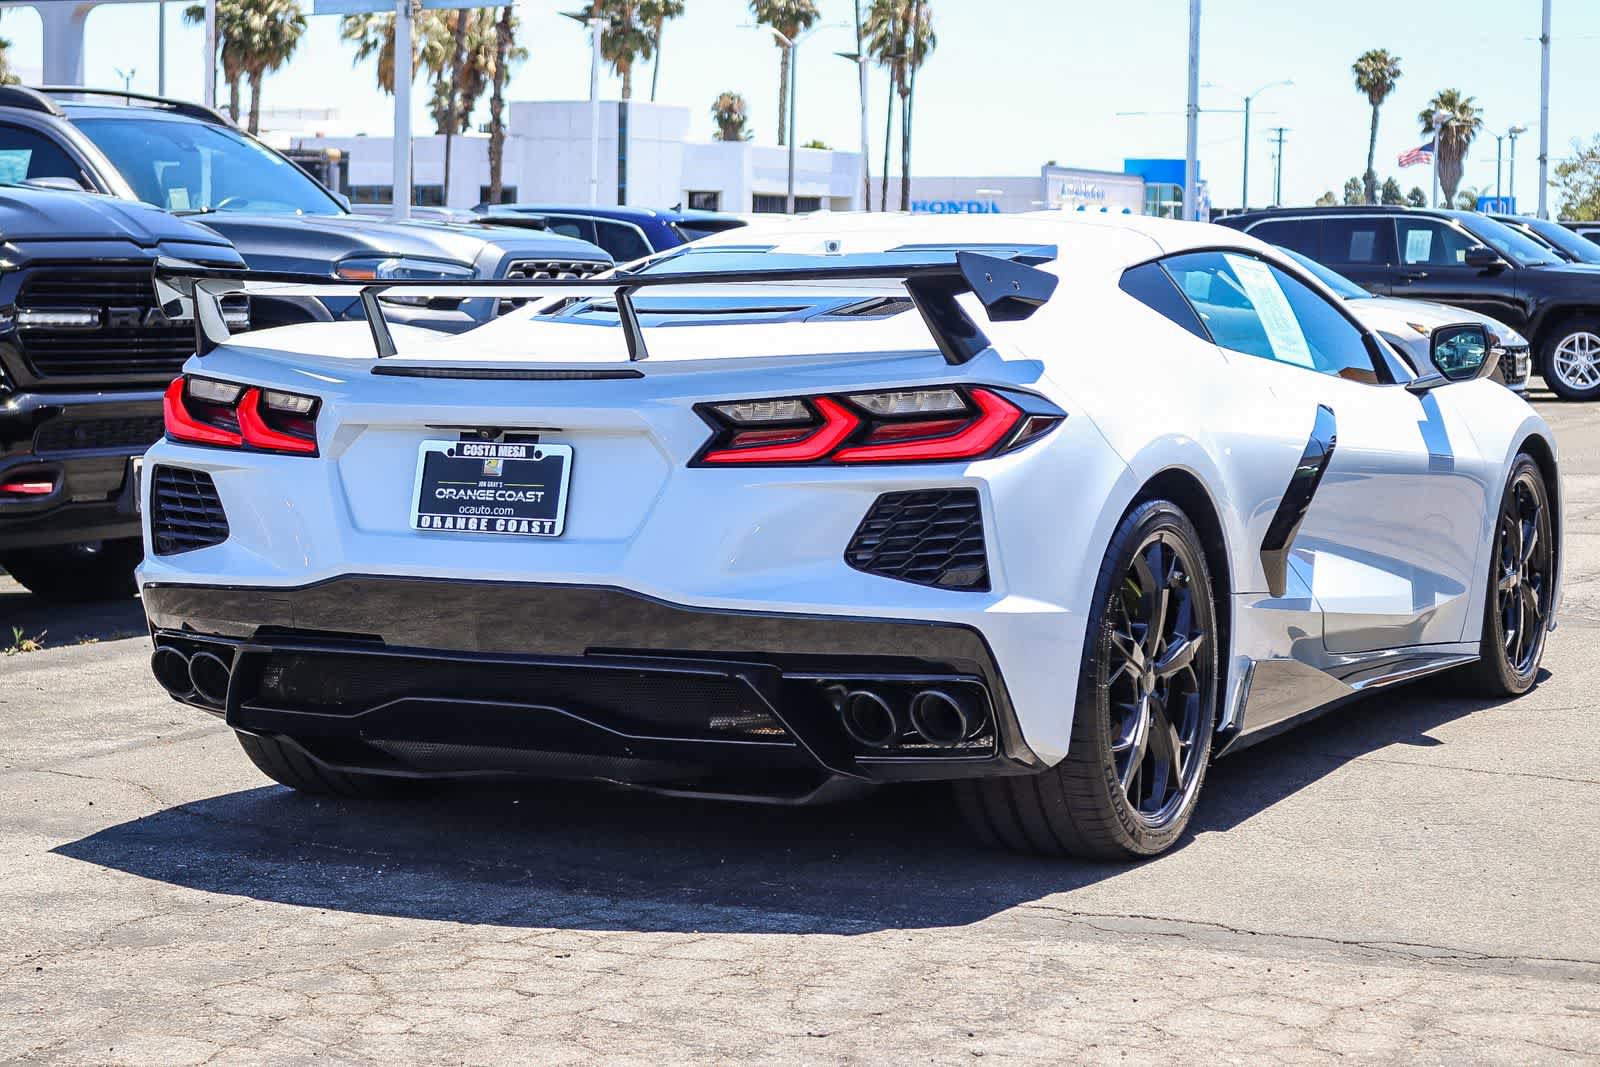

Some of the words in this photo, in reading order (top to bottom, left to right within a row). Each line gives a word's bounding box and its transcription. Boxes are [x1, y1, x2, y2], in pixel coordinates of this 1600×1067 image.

[463, 444, 497, 457] COSTA
[498, 445, 526, 458] MESA
[458, 505, 514, 516] ocauto.com
[421, 516, 488, 531] ORANGE
[496, 519, 553, 534] COAST
